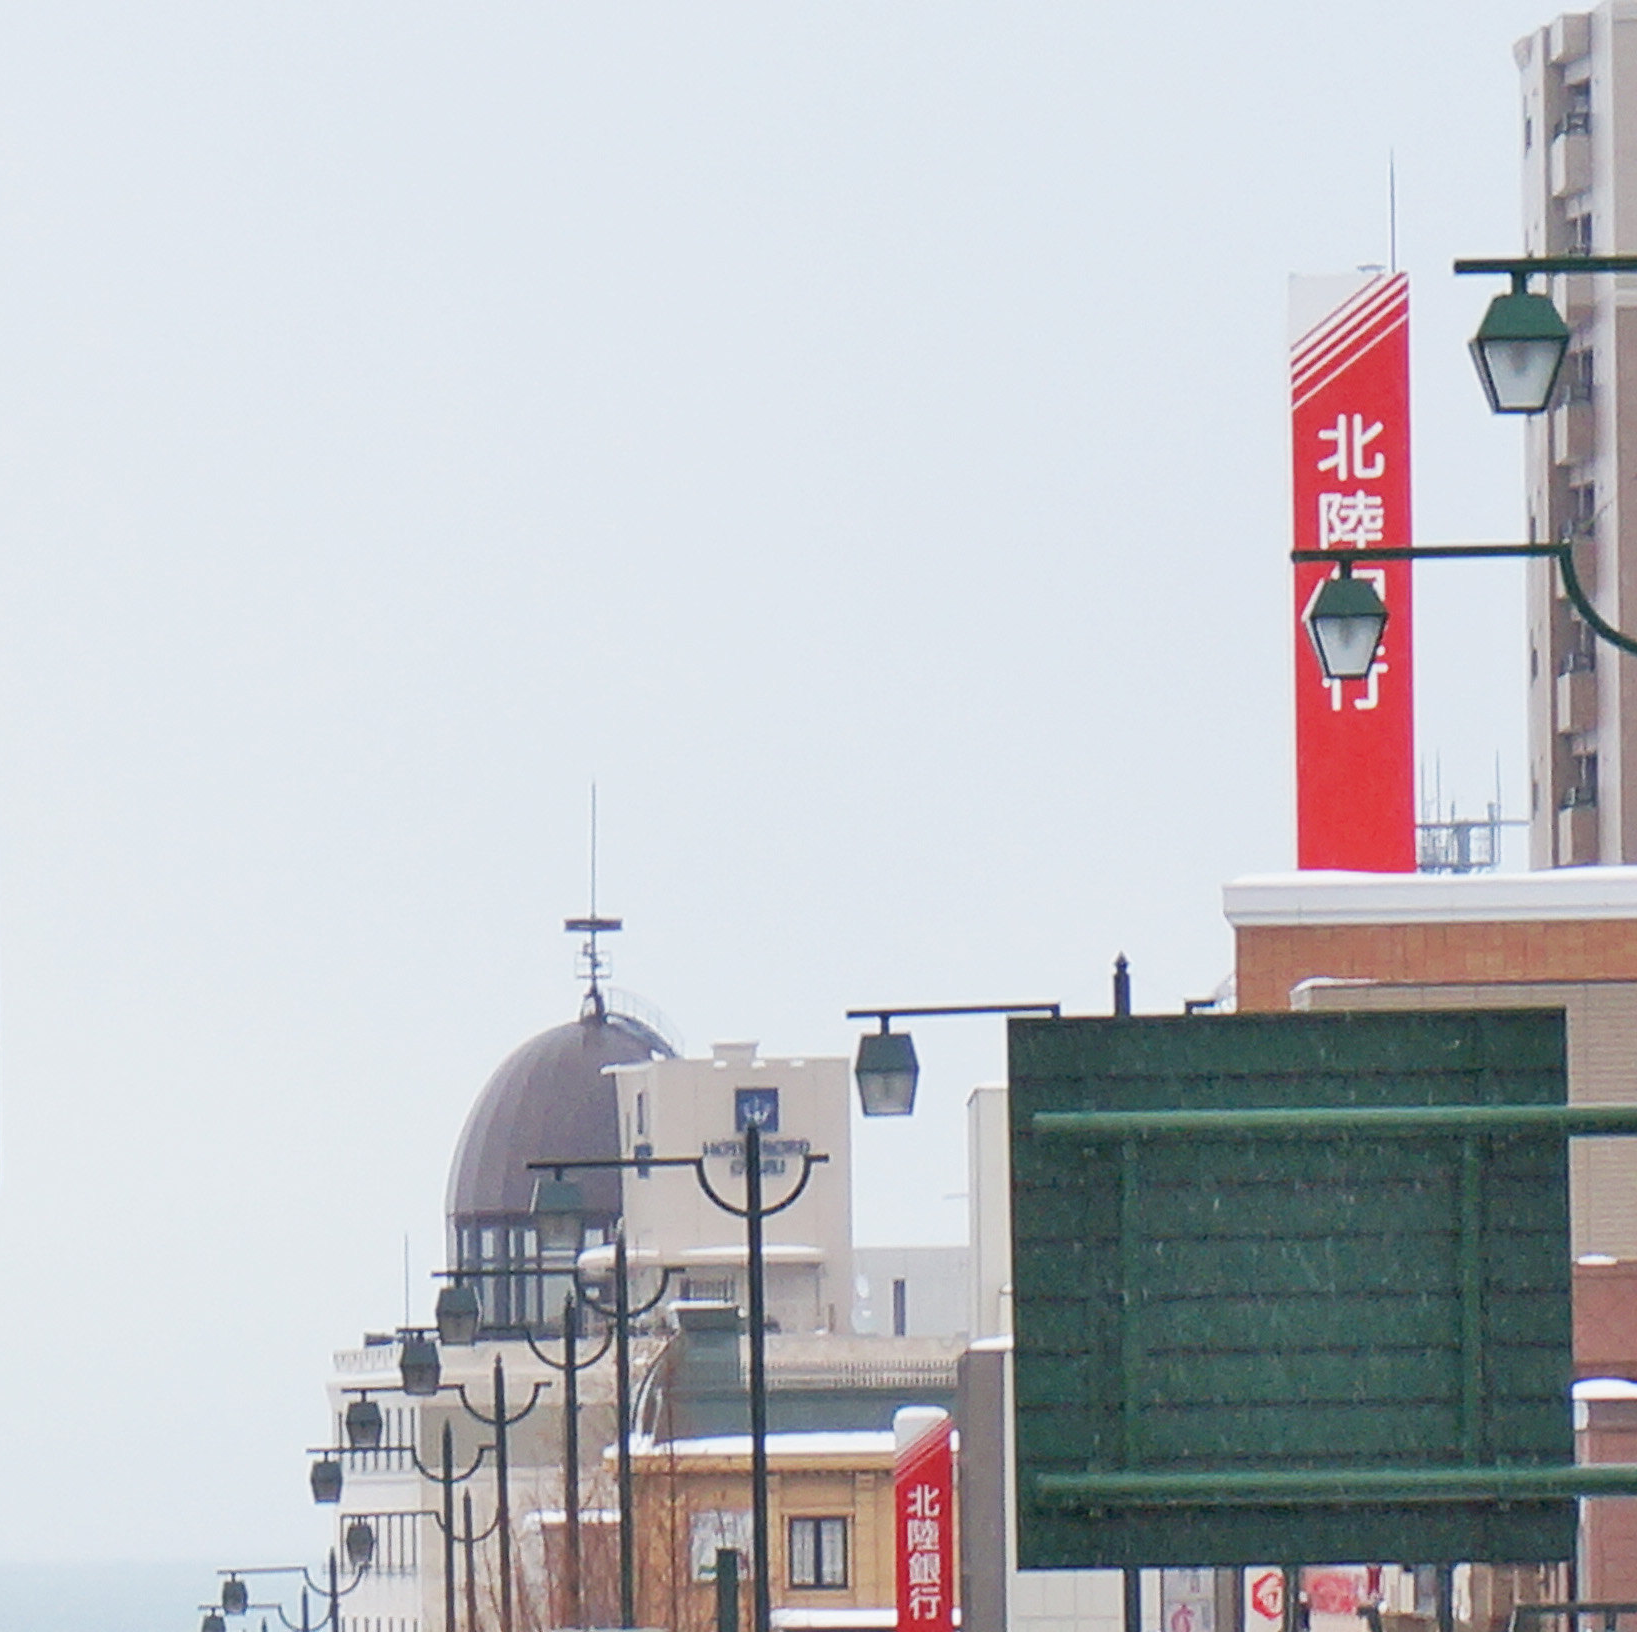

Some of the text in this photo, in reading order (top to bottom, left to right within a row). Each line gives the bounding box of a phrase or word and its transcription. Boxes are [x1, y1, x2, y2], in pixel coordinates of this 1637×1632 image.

[1317, 413, 1388, 711] 北陸行
[907, 1484, 942, 1620] 北陸銀行
